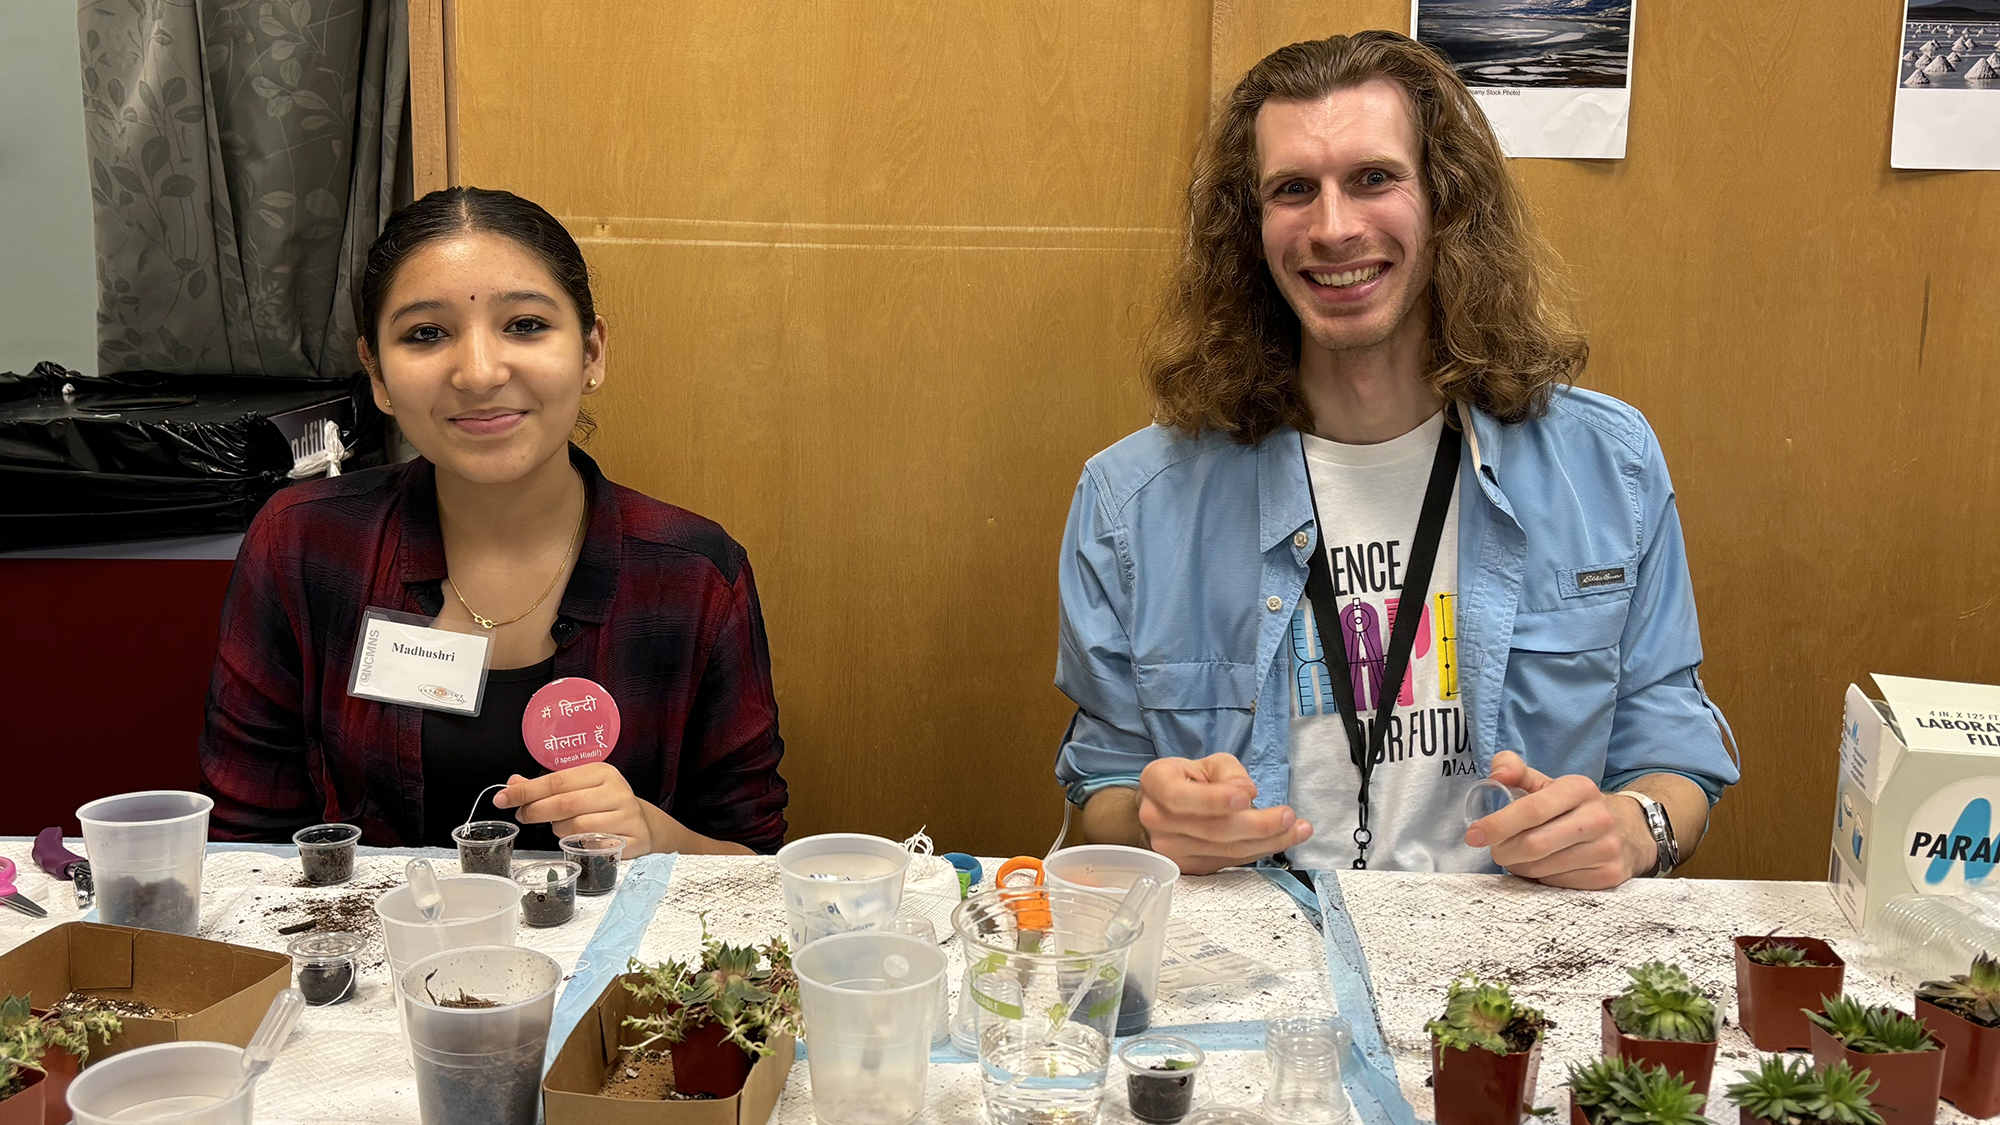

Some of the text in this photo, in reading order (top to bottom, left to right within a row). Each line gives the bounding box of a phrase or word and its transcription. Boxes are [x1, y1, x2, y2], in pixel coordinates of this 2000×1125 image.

[1502, 89, 1521, 97] Photo)
[391, 642, 456, 662] Madhushri
[541, 694, 597, 719] मैं हिन्दी
[1966, 712, 1985, 720] 125
[543, 731, 587, 751] बोलता
[1408, 707, 1472, 758] FUTU
[1966, 733, 2000, 747] FIL
[560, 753, 580, 764] speak
